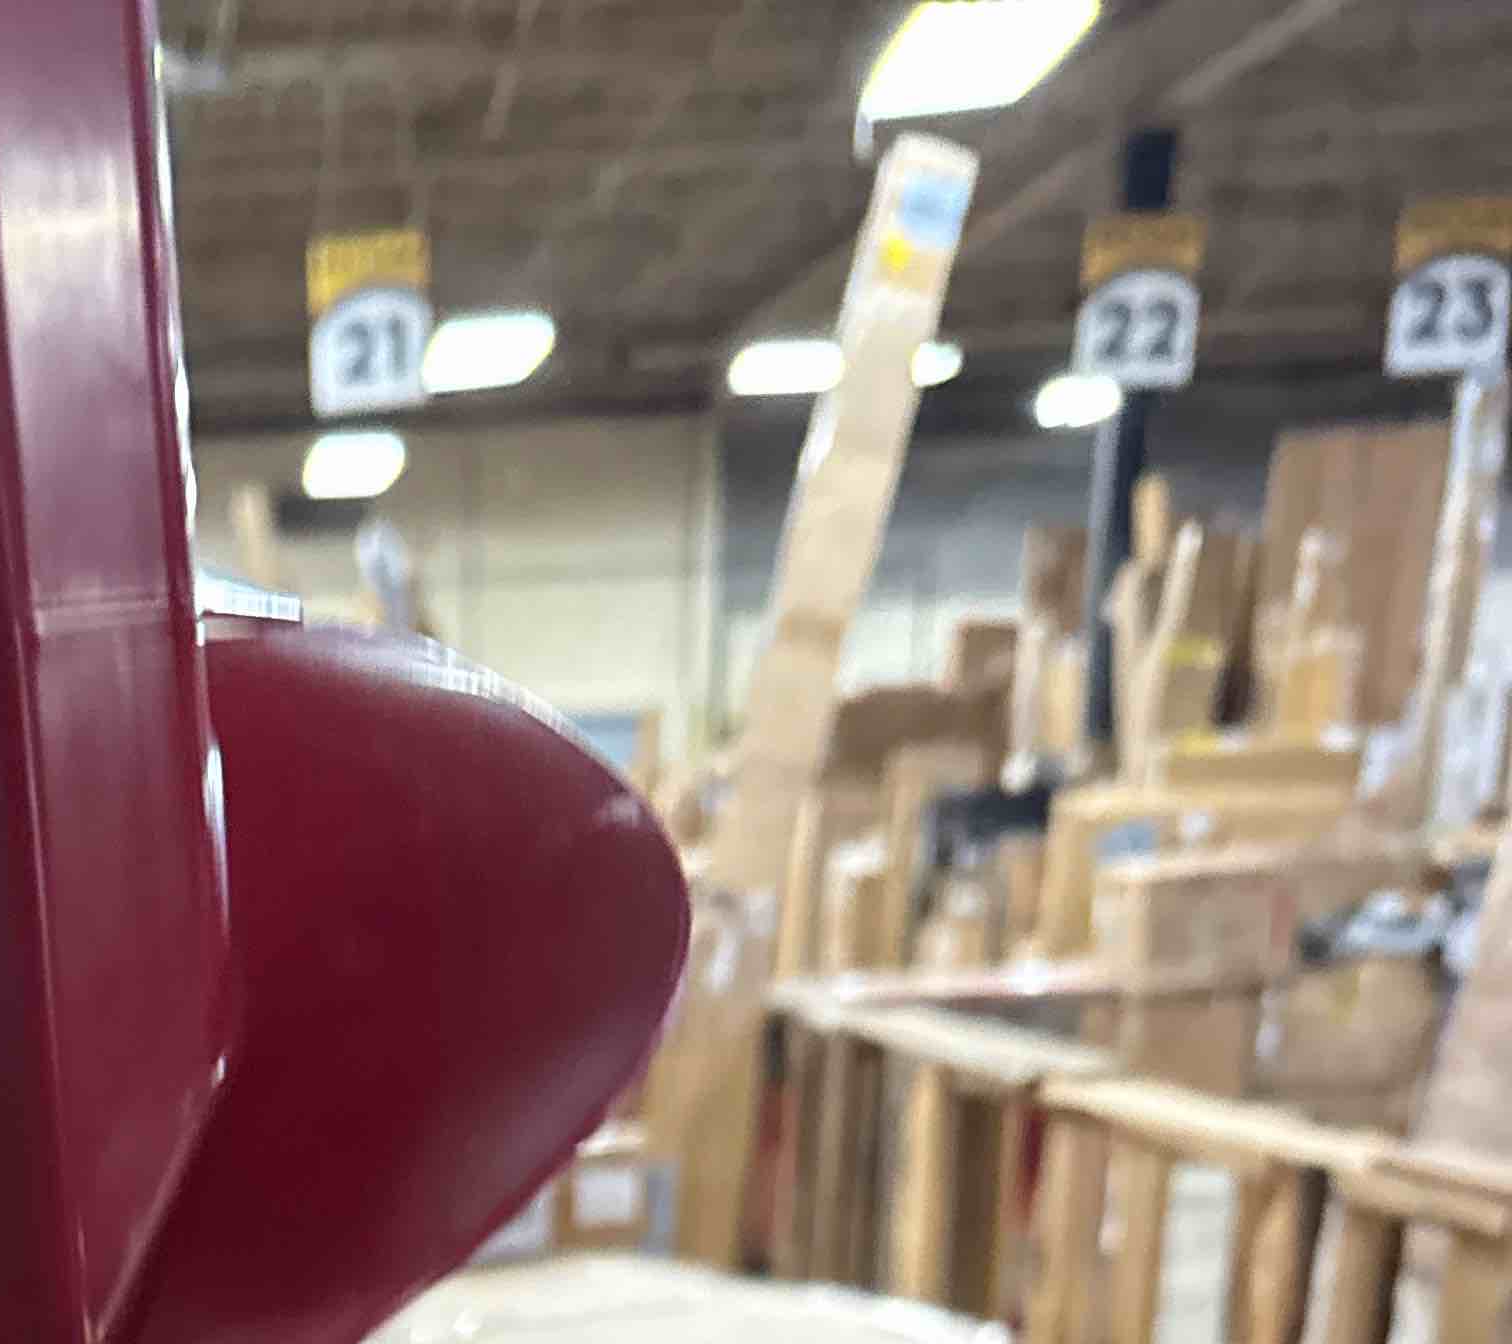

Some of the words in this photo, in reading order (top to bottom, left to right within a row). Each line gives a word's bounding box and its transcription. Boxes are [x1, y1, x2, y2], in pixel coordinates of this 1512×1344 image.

[1095, 299, 1180, 362] 22
[1402, 276, 1493, 345] 23
[342, 314, 410, 384] 21
